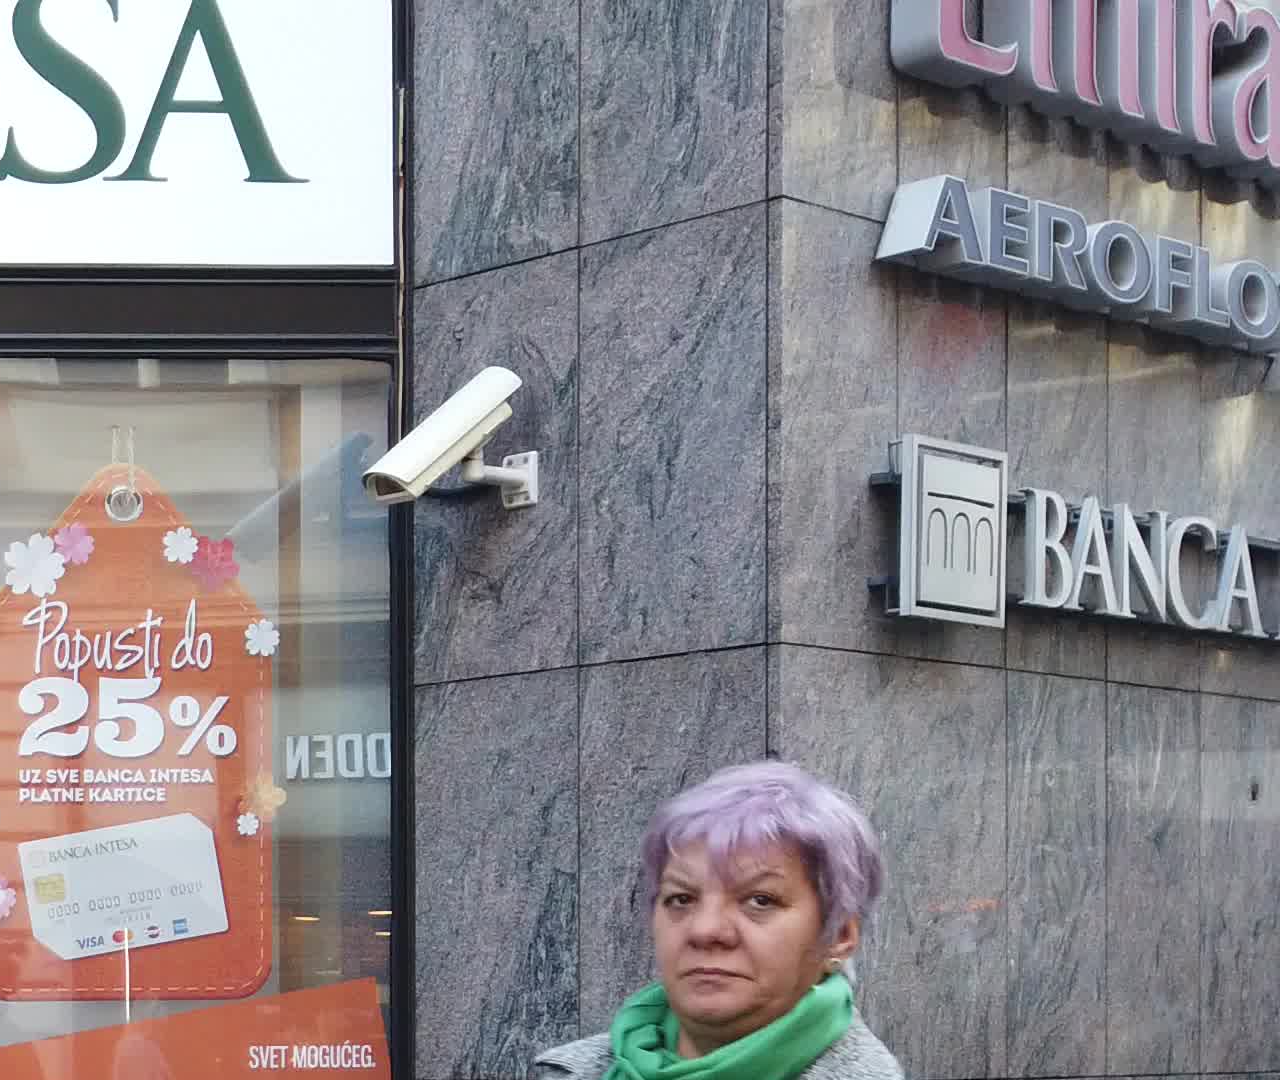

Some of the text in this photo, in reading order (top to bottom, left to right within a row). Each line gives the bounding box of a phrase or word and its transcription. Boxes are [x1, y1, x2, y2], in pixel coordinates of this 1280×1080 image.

[878, 174, 1280, 338] AEROFLO
[1017, 487, 1270, 639] BANCA
[22, 598, 214, 681] Popusti do
[17, 676, 237, 758] 25%
[18, 768, 215, 784] UZ SVE BANCA INTESA
[18, 786, 167, 802] PLATNE KARTICE
[48, 837, 138, 863] BANCA INTESA
[75, 935, 105, 949] VISA
[248, 1040, 376, 1069] SVET MOGUĆEG.
